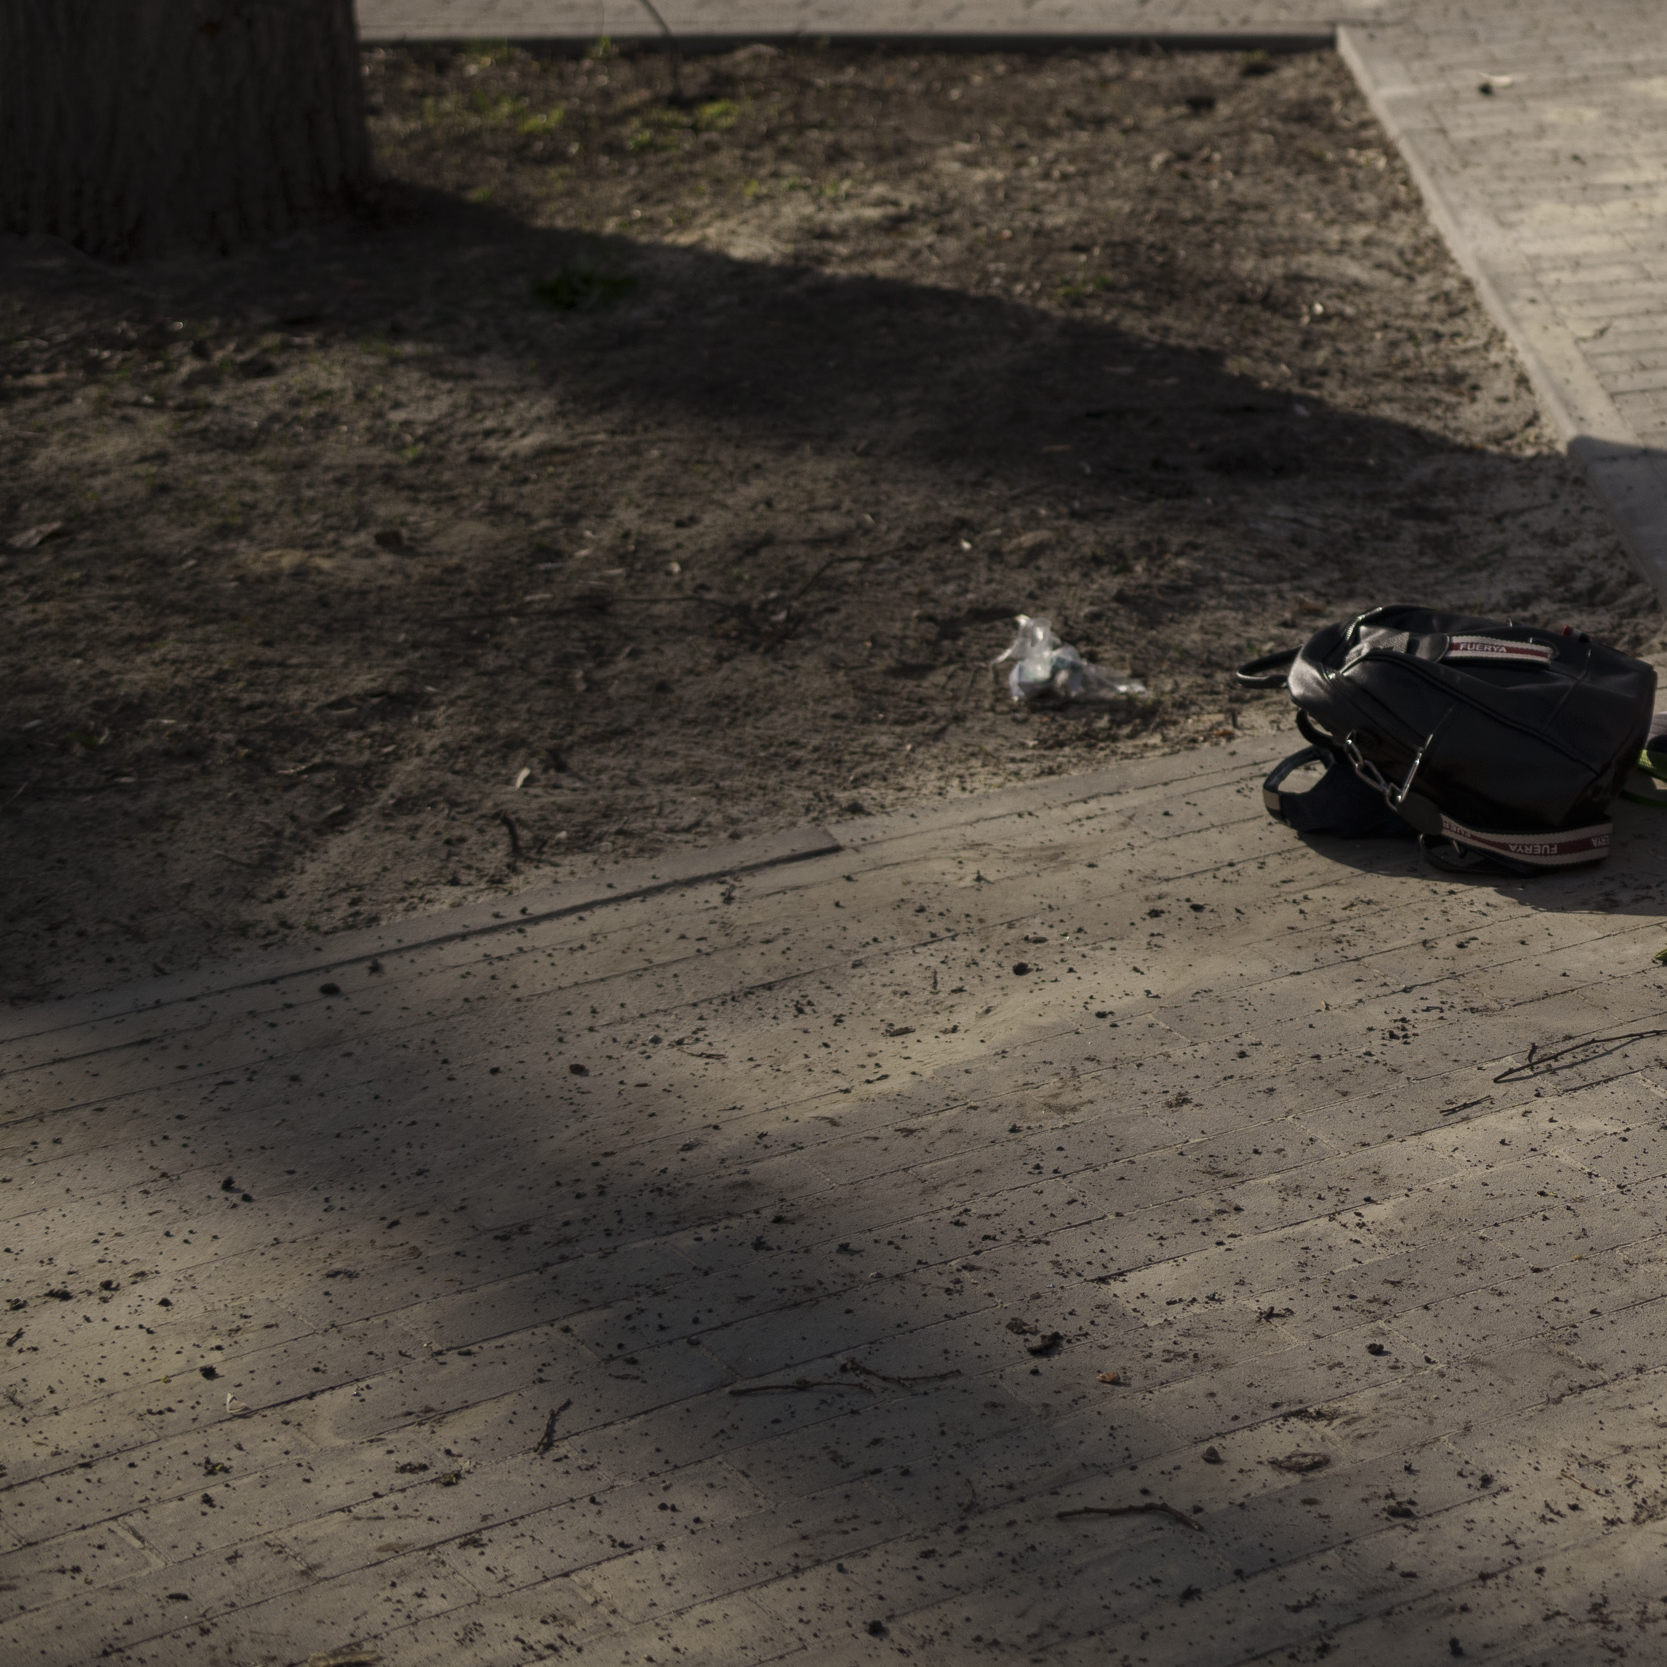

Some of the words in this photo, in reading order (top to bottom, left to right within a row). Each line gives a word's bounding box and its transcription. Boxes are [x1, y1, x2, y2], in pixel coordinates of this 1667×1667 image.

[1459, 643, 1507, 653] FUERYA
[1591, 835, 1610, 847] ERYA
[1508, 843, 1557, 855] FUERYA
